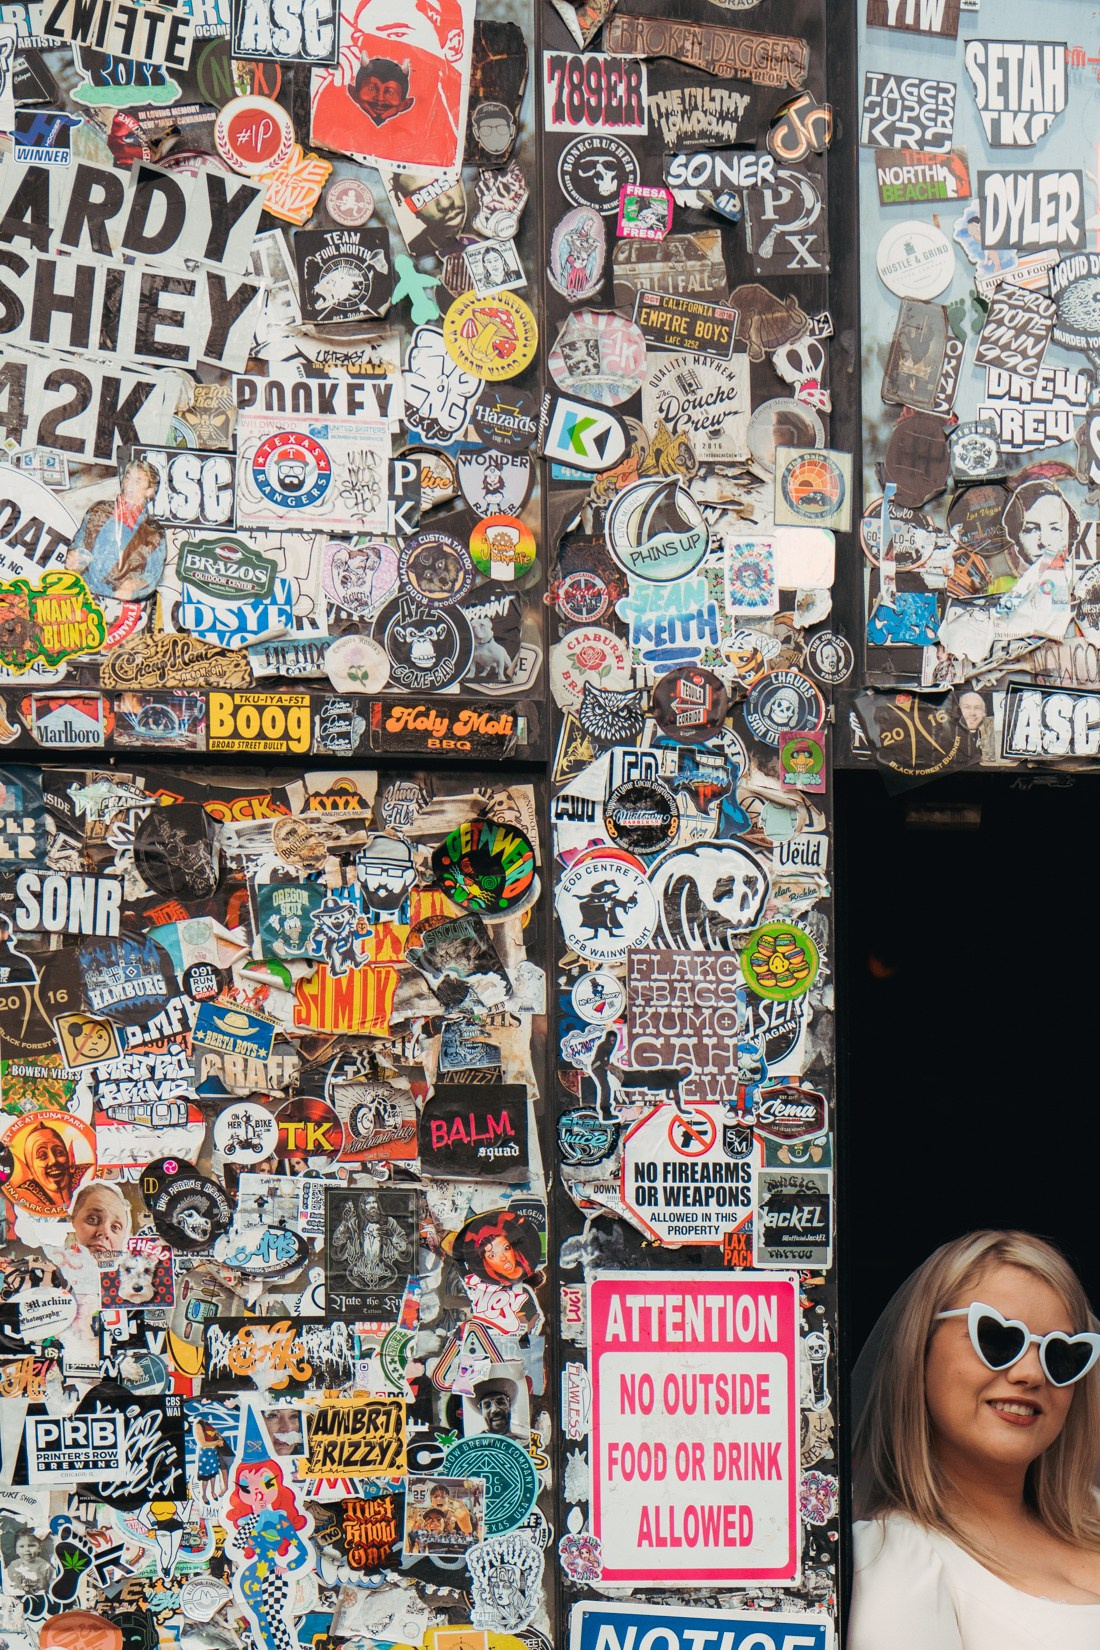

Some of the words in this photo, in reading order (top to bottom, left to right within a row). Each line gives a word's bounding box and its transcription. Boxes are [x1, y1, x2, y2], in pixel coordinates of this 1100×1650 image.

[866, 73, 954, 103] TAGER
[965, 42, 1065, 113] SETAH
[864, 100, 954, 129] SUPER
[17, 149, 70, 163] WINNER
[668, 155, 774, 186] SONER
[626, 186, 666, 198] FRESA
[985, 173, 1080, 246] DYLER
[623, 228, 664, 240] FRESA
[881, 259, 914, 276] HUSTLE
[923, 245, 948, 260] GRIND
[1049, 257, 1088, 288] LIQUID
[663, 297, 713, 317] CALIFORNIA
[640, 312, 690, 334] EMPIRE
[695, 322, 730, 343] BOYS
[1054, 329, 1086, 346] MURDER
[263, 434, 321, 462] TEXAS
[256, 474, 331, 507] RANGERS
[629, 542, 673, 567] PHINS
[674, 535, 701, 553] UP
[185, 555, 266, 584] BRAZOS
[37, 595, 82, 623] MANY
[44, 614, 99, 648] BLUNTS
[633, 600, 720, 648] KEITH
[239, 695, 306, 704] TKU-IYA-FST
[37, 721, 100, 744] Marlboro
[210, 693, 310, 752] Boog
[386, 704, 449, 733] Holy
[212, 742, 237, 750] BROAD
[239, 742, 263, 750] STREET
[264, 742, 284, 750] BULLY
[427, 736, 471, 750] BBQ
[16, 873, 121, 935] SONR
[90, 976, 166, 1010] HAMBURG
[12, 1067, 48, 1078] BOWEN
[53, 1067, 81, 1080] VIBES
[228, 1119, 243, 1130] HER
[255, 1118, 273, 1129] BIKE
[635, 1163, 658, 1181] NO
[663, 1162, 751, 1183] FIREARMS
[636, 1187, 657, 1207] OR
[661, 1187, 751, 1207] WEAPONS
[650, 1213, 696, 1222] ALLOWED
[699, 1213, 711, 1222] IN
[714, 1213, 737, 1222] THIS
[668, 1225, 720, 1236] PROPERTY
[605, 1296, 777, 1343] ATTENTION
[620, 1374, 653, 1415] NO
[665, 1374, 770, 1415] OUTSIDE
[38, 1419, 118, 1449] PRB
[37, 1452, 89, 1460] PRINTER'S
[92, 1452, 118, 1460] ROW
[608, 1442, 665, 1481] FOOD
[675, 1442, 704, 1481] OR
[714, 1442, 782, 1481] DRINK
[637, 1505, 752, 1548] ALLOWED
